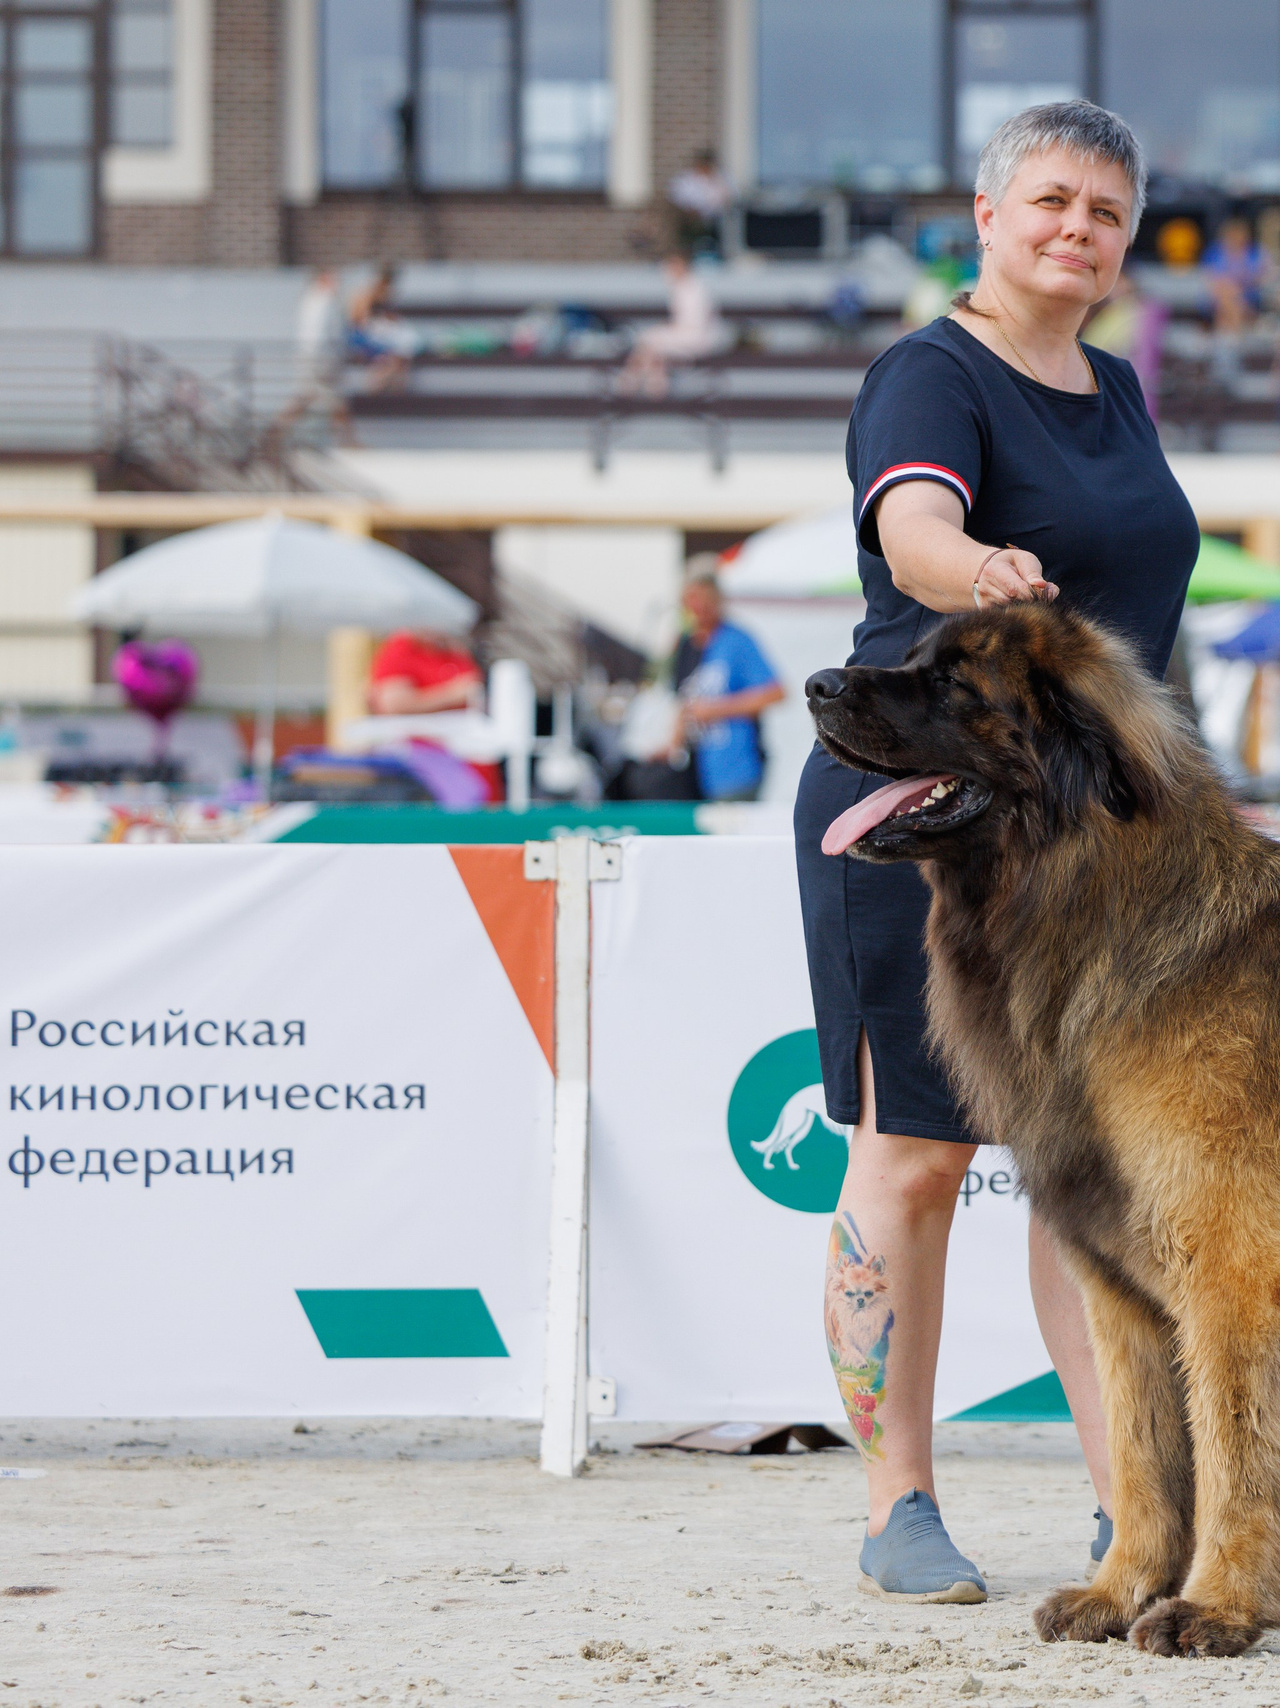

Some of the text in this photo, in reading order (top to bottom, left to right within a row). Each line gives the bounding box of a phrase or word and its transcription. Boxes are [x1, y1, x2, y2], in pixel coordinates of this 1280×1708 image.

[9, 1008, 307, 1049] Российская
[9, 1081, 427, 1112] кинологическая
[8, 1134, 295, 1188] федерация
